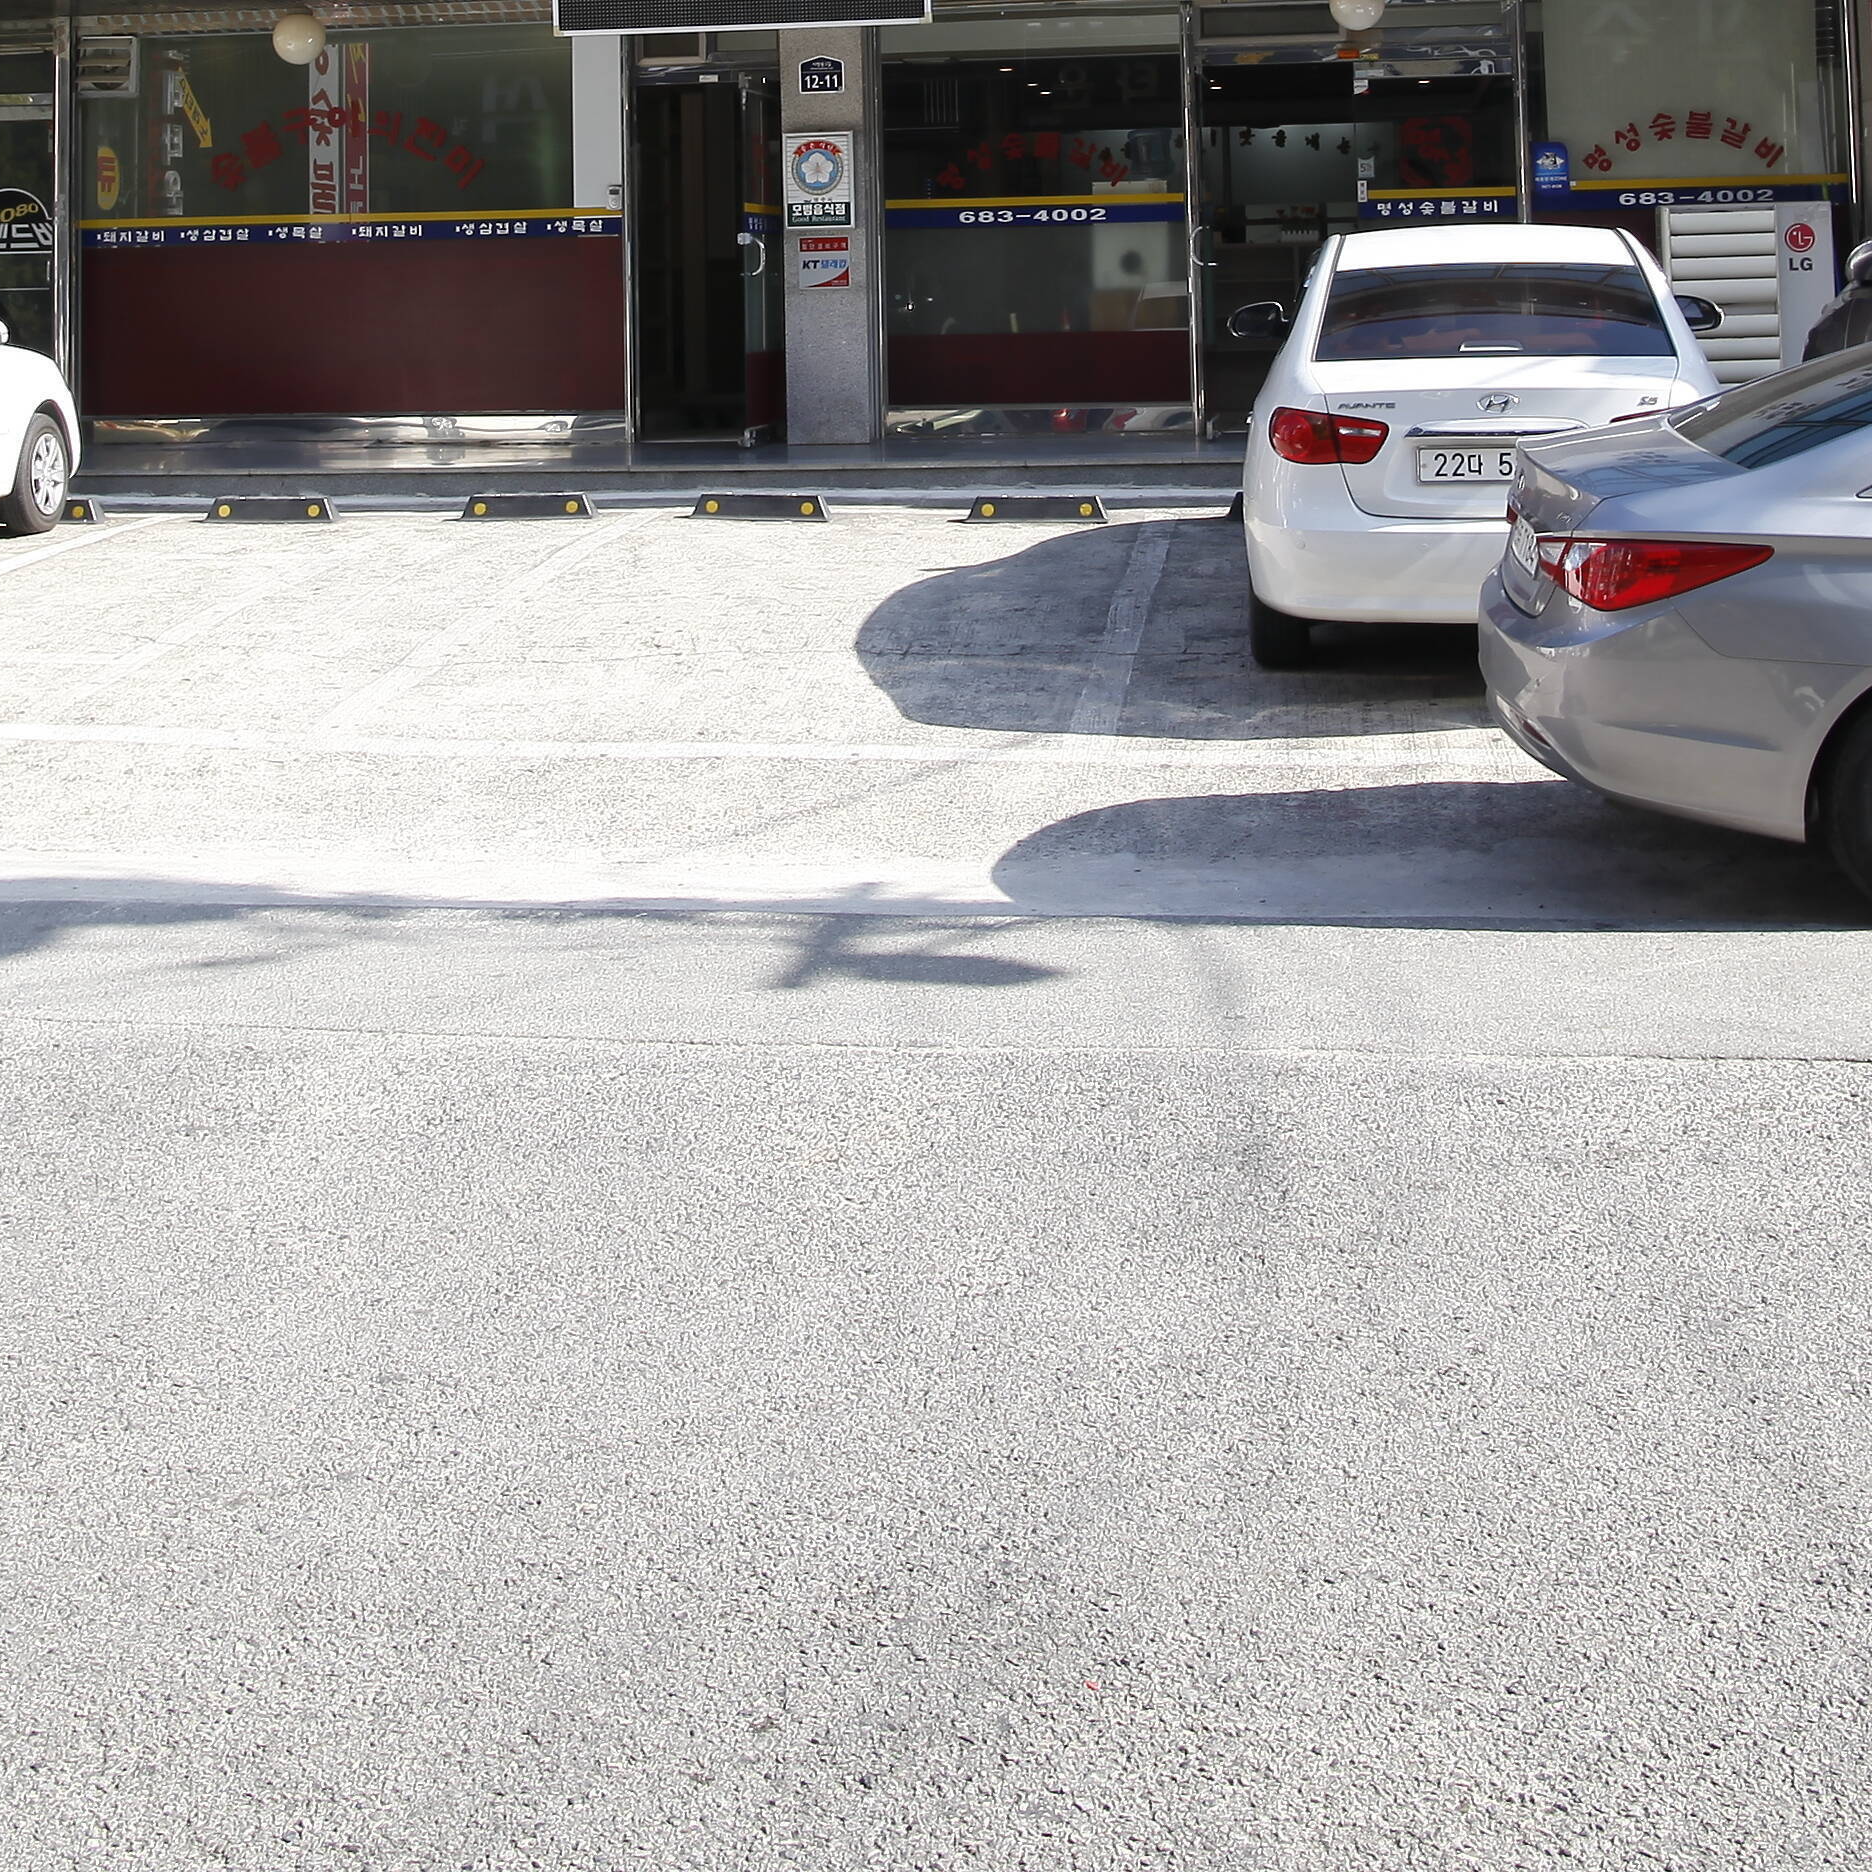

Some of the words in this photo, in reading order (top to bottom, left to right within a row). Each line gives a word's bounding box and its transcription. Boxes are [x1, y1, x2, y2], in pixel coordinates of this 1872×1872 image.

[804, 74, 838, 89] 12-11
[1582, 110, 1786, 173] 명성숯불갈비
[1618, 188, 1775, 206] 683-4002
[791, 204, 846, 216] 모범음식점
[958, 208, 1107, 224] 683-4002
[1377, 200, 1499, 217] 명성숯불갈비
[103, 229, 165, 244] 돼지갈비
[185, 228, 250, 242] 생삼겹살
[275, 226, 324, 240] 생목살
[358, 224, 423, 238] 돼지갈비
[461, 221, 528, 236] 생삼겹살
[553, 219, 604, 233] 생목살
[1788, 256, 1814, 272] LG
[1337, 400, 1398, 411] AVANTE
[1433, 452, 1484, 478] 22다
